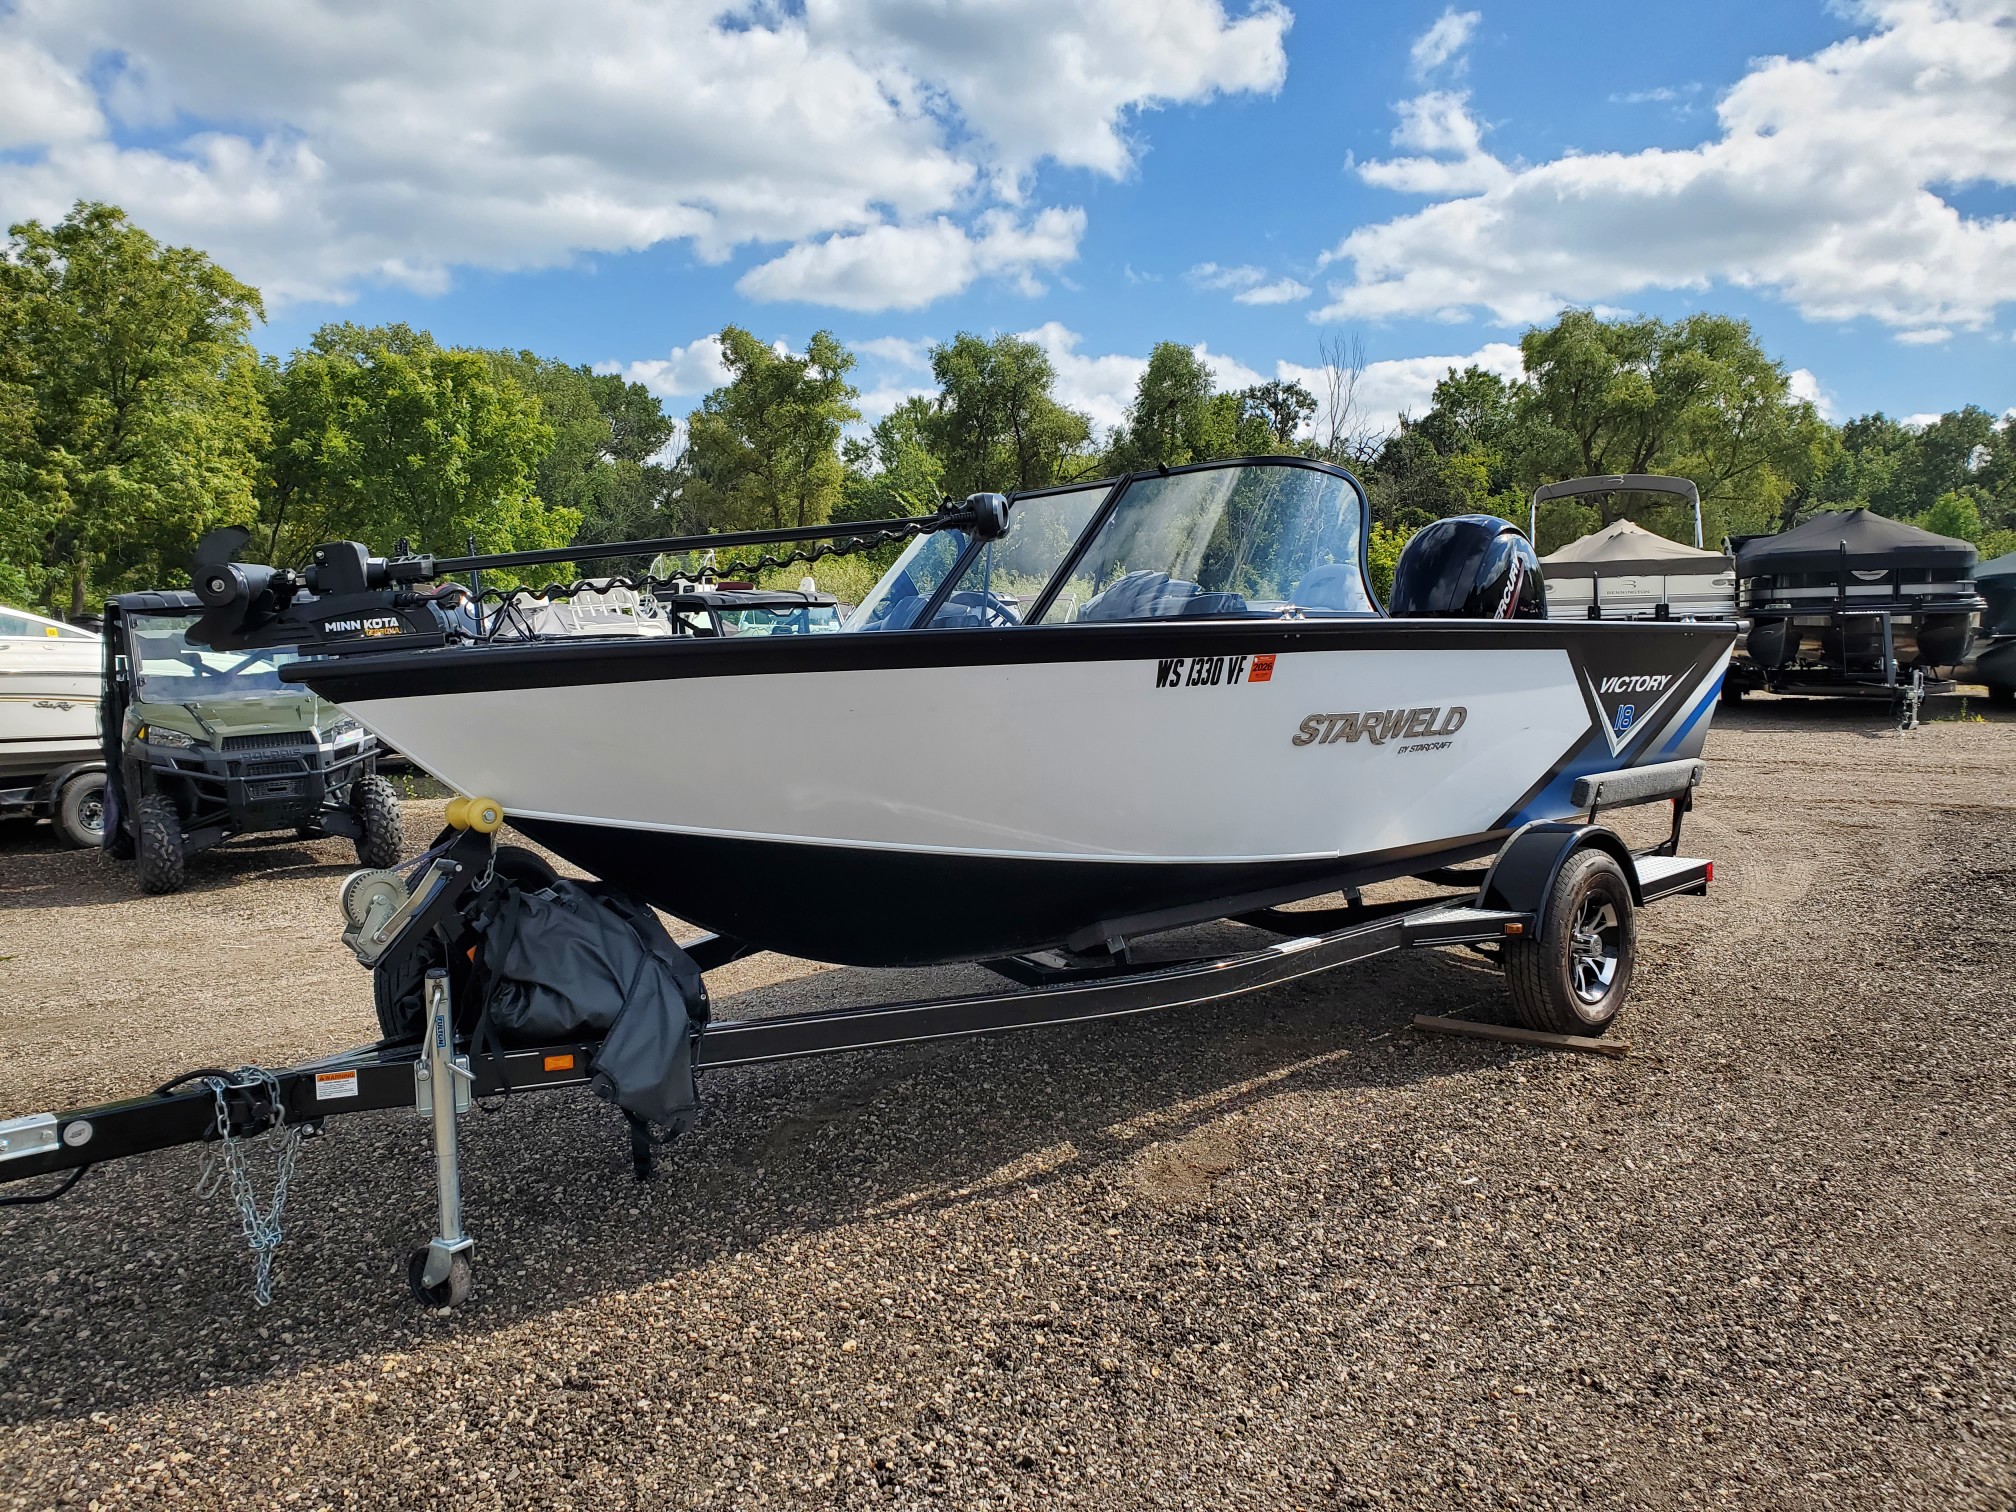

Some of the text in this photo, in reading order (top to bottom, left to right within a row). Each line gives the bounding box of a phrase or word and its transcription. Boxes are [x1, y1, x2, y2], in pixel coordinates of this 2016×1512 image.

[1494, 552, 1520, 619] ERCURY
[324, 617, 399, 632] MINN KOTA
[1156, 656, 1247, 688] WS 1330 VF
[1253, 663, 1273, 672] 2026
[1600, 675, 1672, 693] VICTORY
[1292, 706, 1467, 746] STARWELD
[1614, 704, 1634, 730] 18
[240, 749, 302, 760] POLARIS
[1397, 741, 1453, 754] BY STARCRAFT
[436, 1018, 444, 1045] FULTON
[325, 1072, 354, 1080] WARNING
